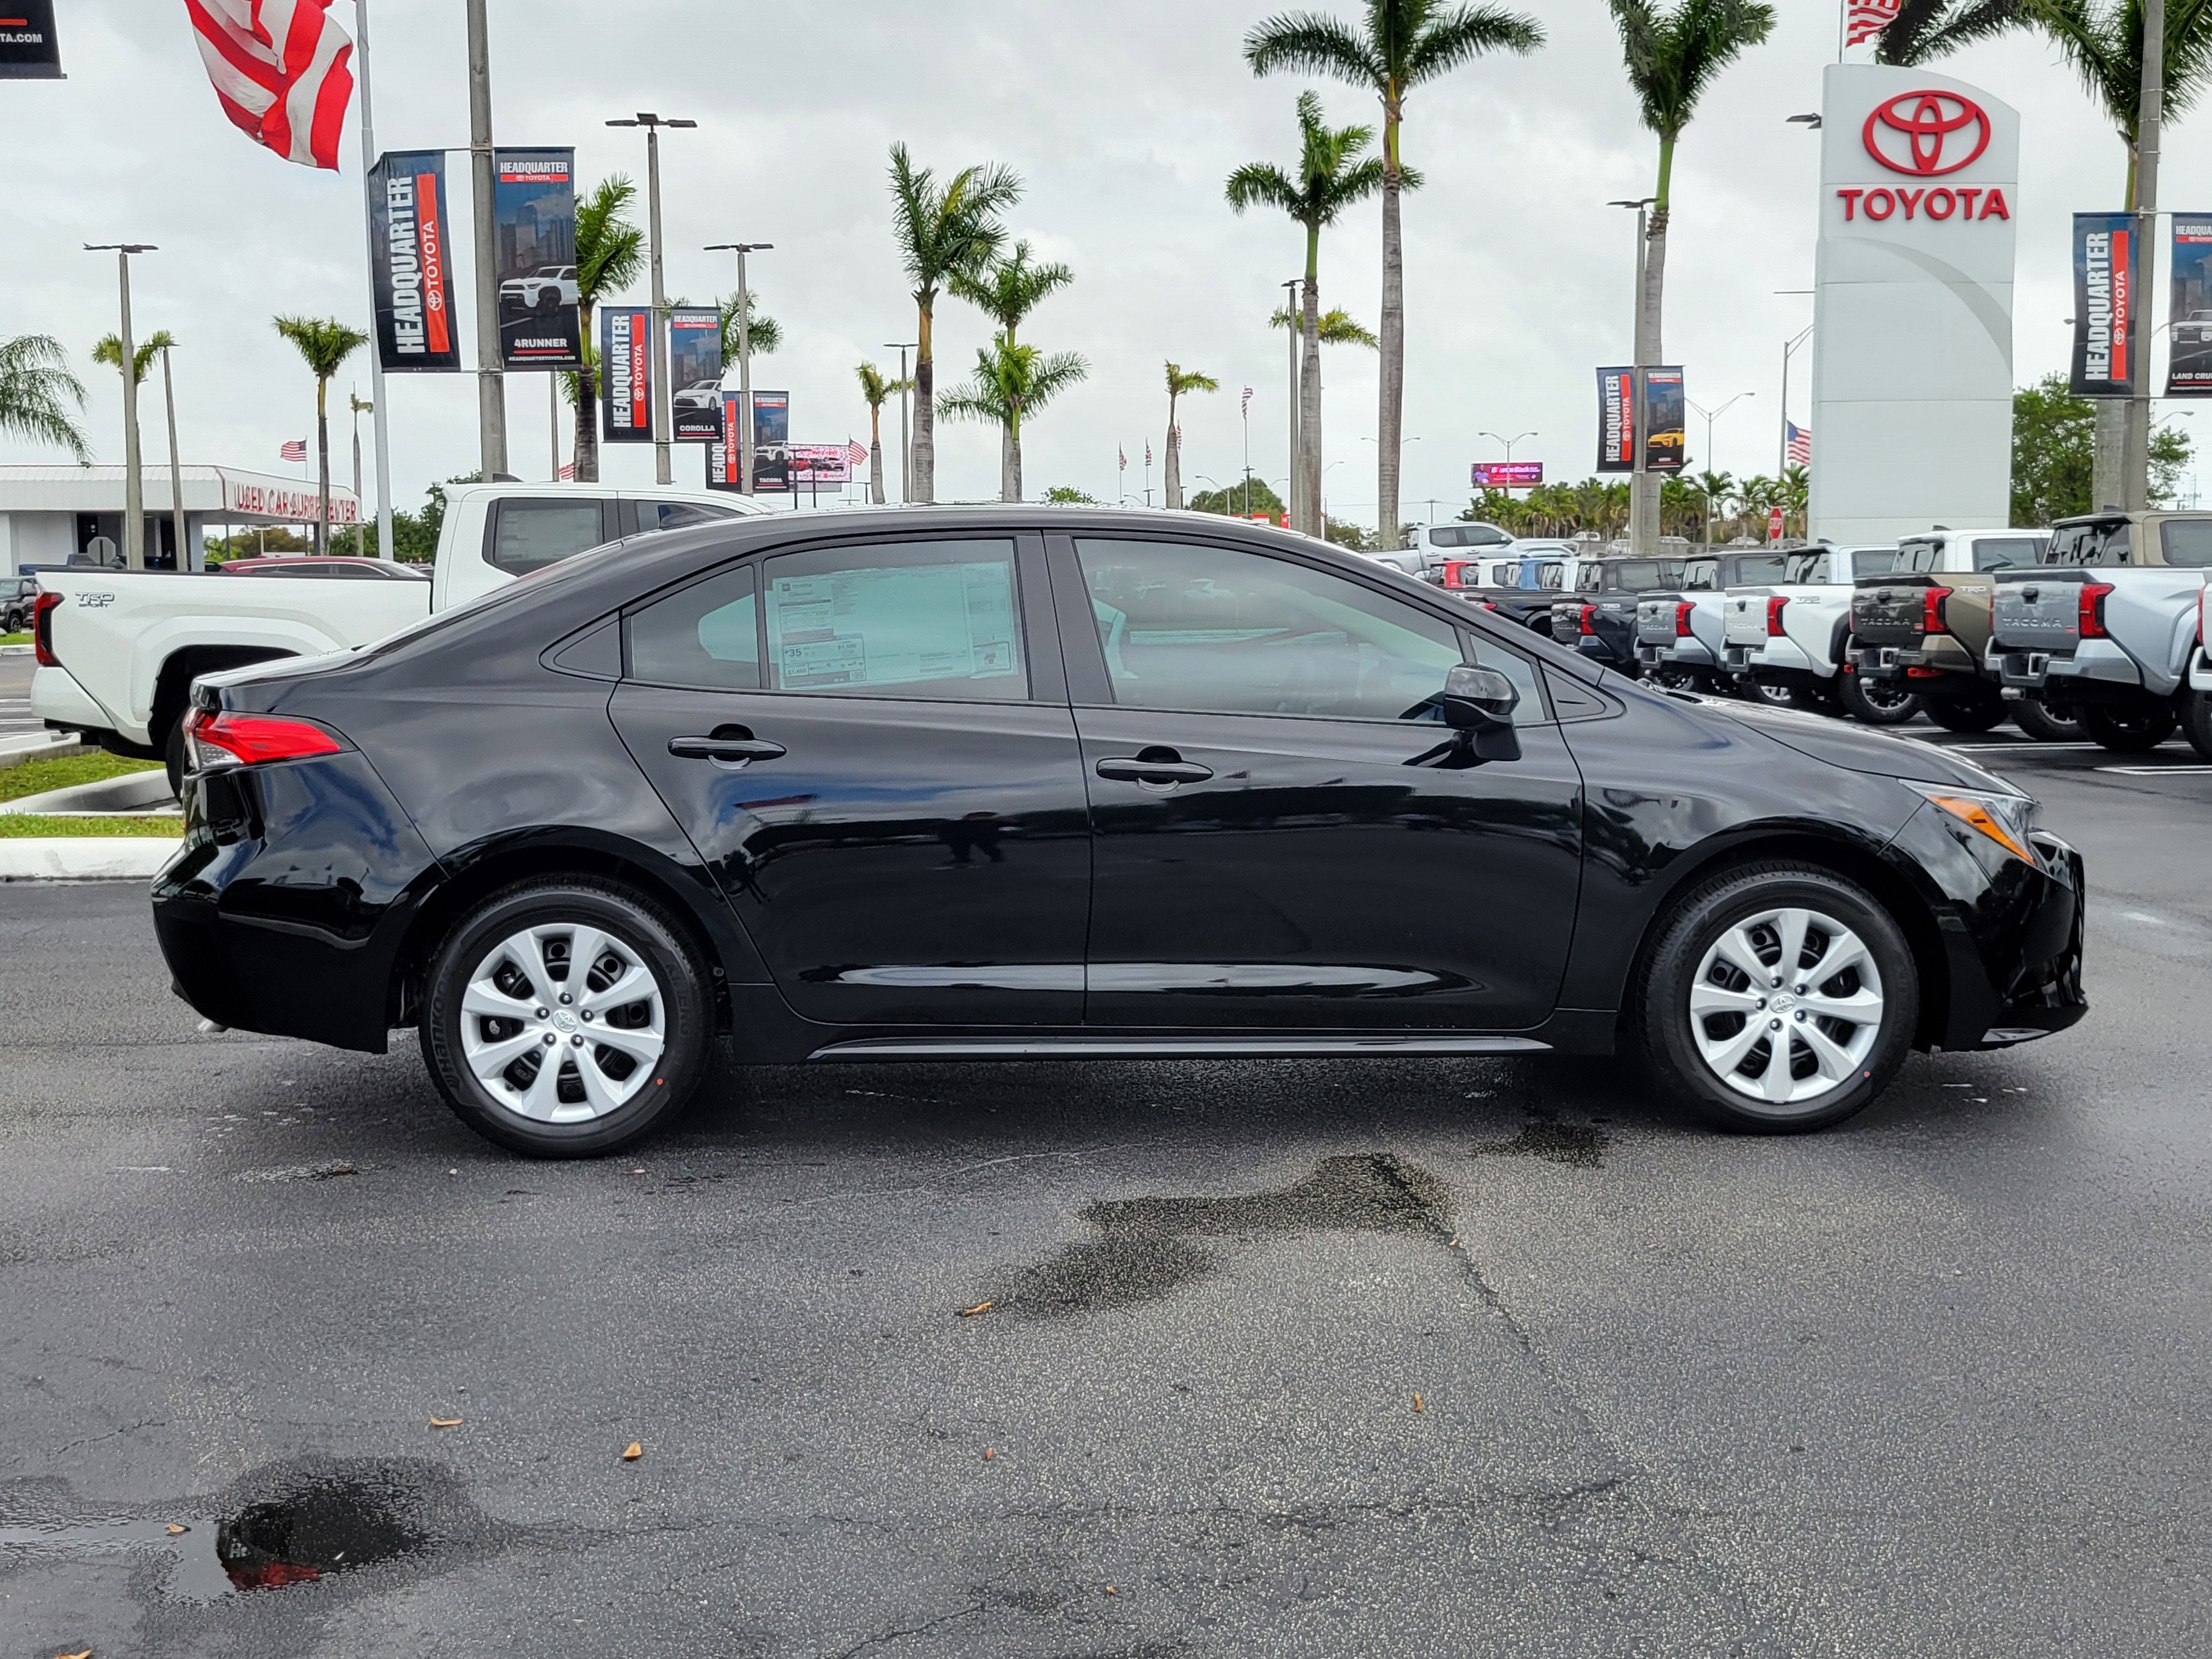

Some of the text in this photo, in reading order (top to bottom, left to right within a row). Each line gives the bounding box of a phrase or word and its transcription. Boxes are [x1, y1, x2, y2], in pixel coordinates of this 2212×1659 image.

[500, 162, 568, 174] HEADQUARTER
[1836, 188, 2010, 221] TOYOTA
[387, 176, 426, 353] HEADQUARTER
[423, 221, 439, 289] TOYOTA
[2085, 232, 2113, 380] HEADQUARTER
[2115, 270, 2126, 326] TOYOTA
[514, 338, 568, 347] 4RUNNER
[612, 315, 633, 428] HEADQUARTER
[634, 344, 644, 387] TOYOTA
[1605, 375, 1622, 462] HEADQUARTER
[1623, 397, 1631, 430] TOYOTA
[236, 484, 264, 511] USED
[267, 489, 289, 515] CAR
[75, 592, 115, 604] TRD
[1959, 585, 1987, 594] TRD
[2002, 618, 2062, 627] TACOMA
[789, 648, 802, 657] 35
